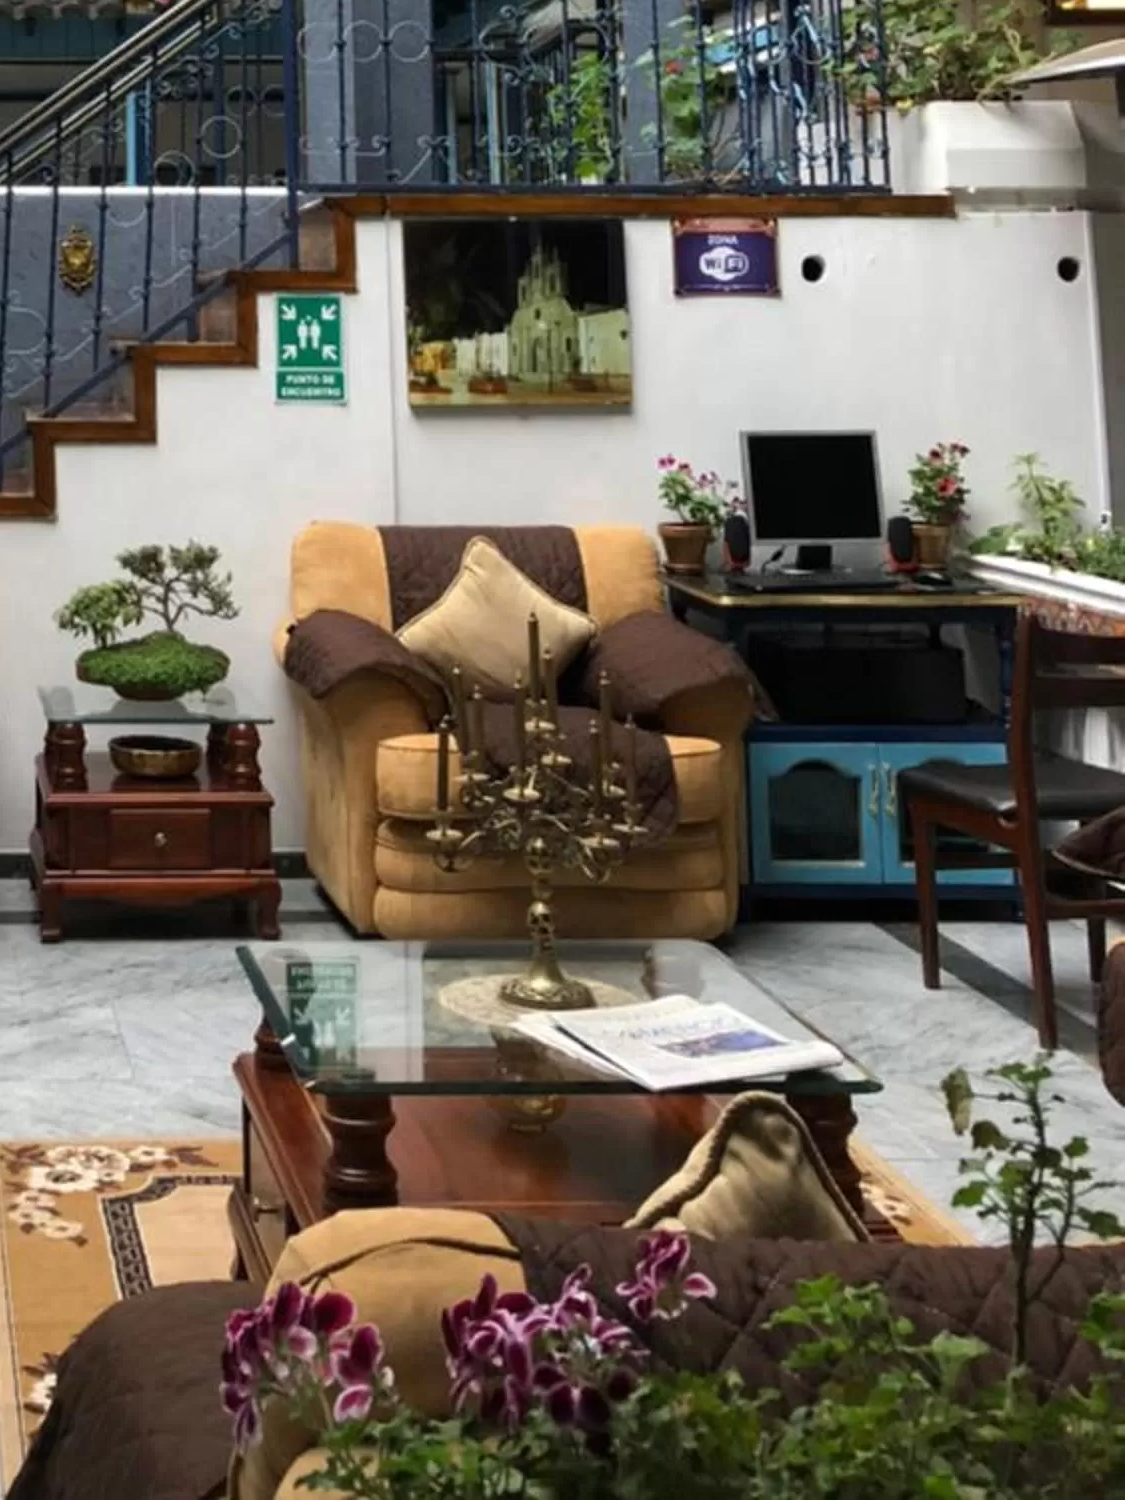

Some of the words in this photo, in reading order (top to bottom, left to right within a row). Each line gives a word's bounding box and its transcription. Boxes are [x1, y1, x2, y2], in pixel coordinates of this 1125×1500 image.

[707, 234, 739, 245] ZONA
[285, 373, 320, 385] PUNTO
[322, 373, 336, 385] DE
[280, 386, 341, 397] ENCUENTRO
